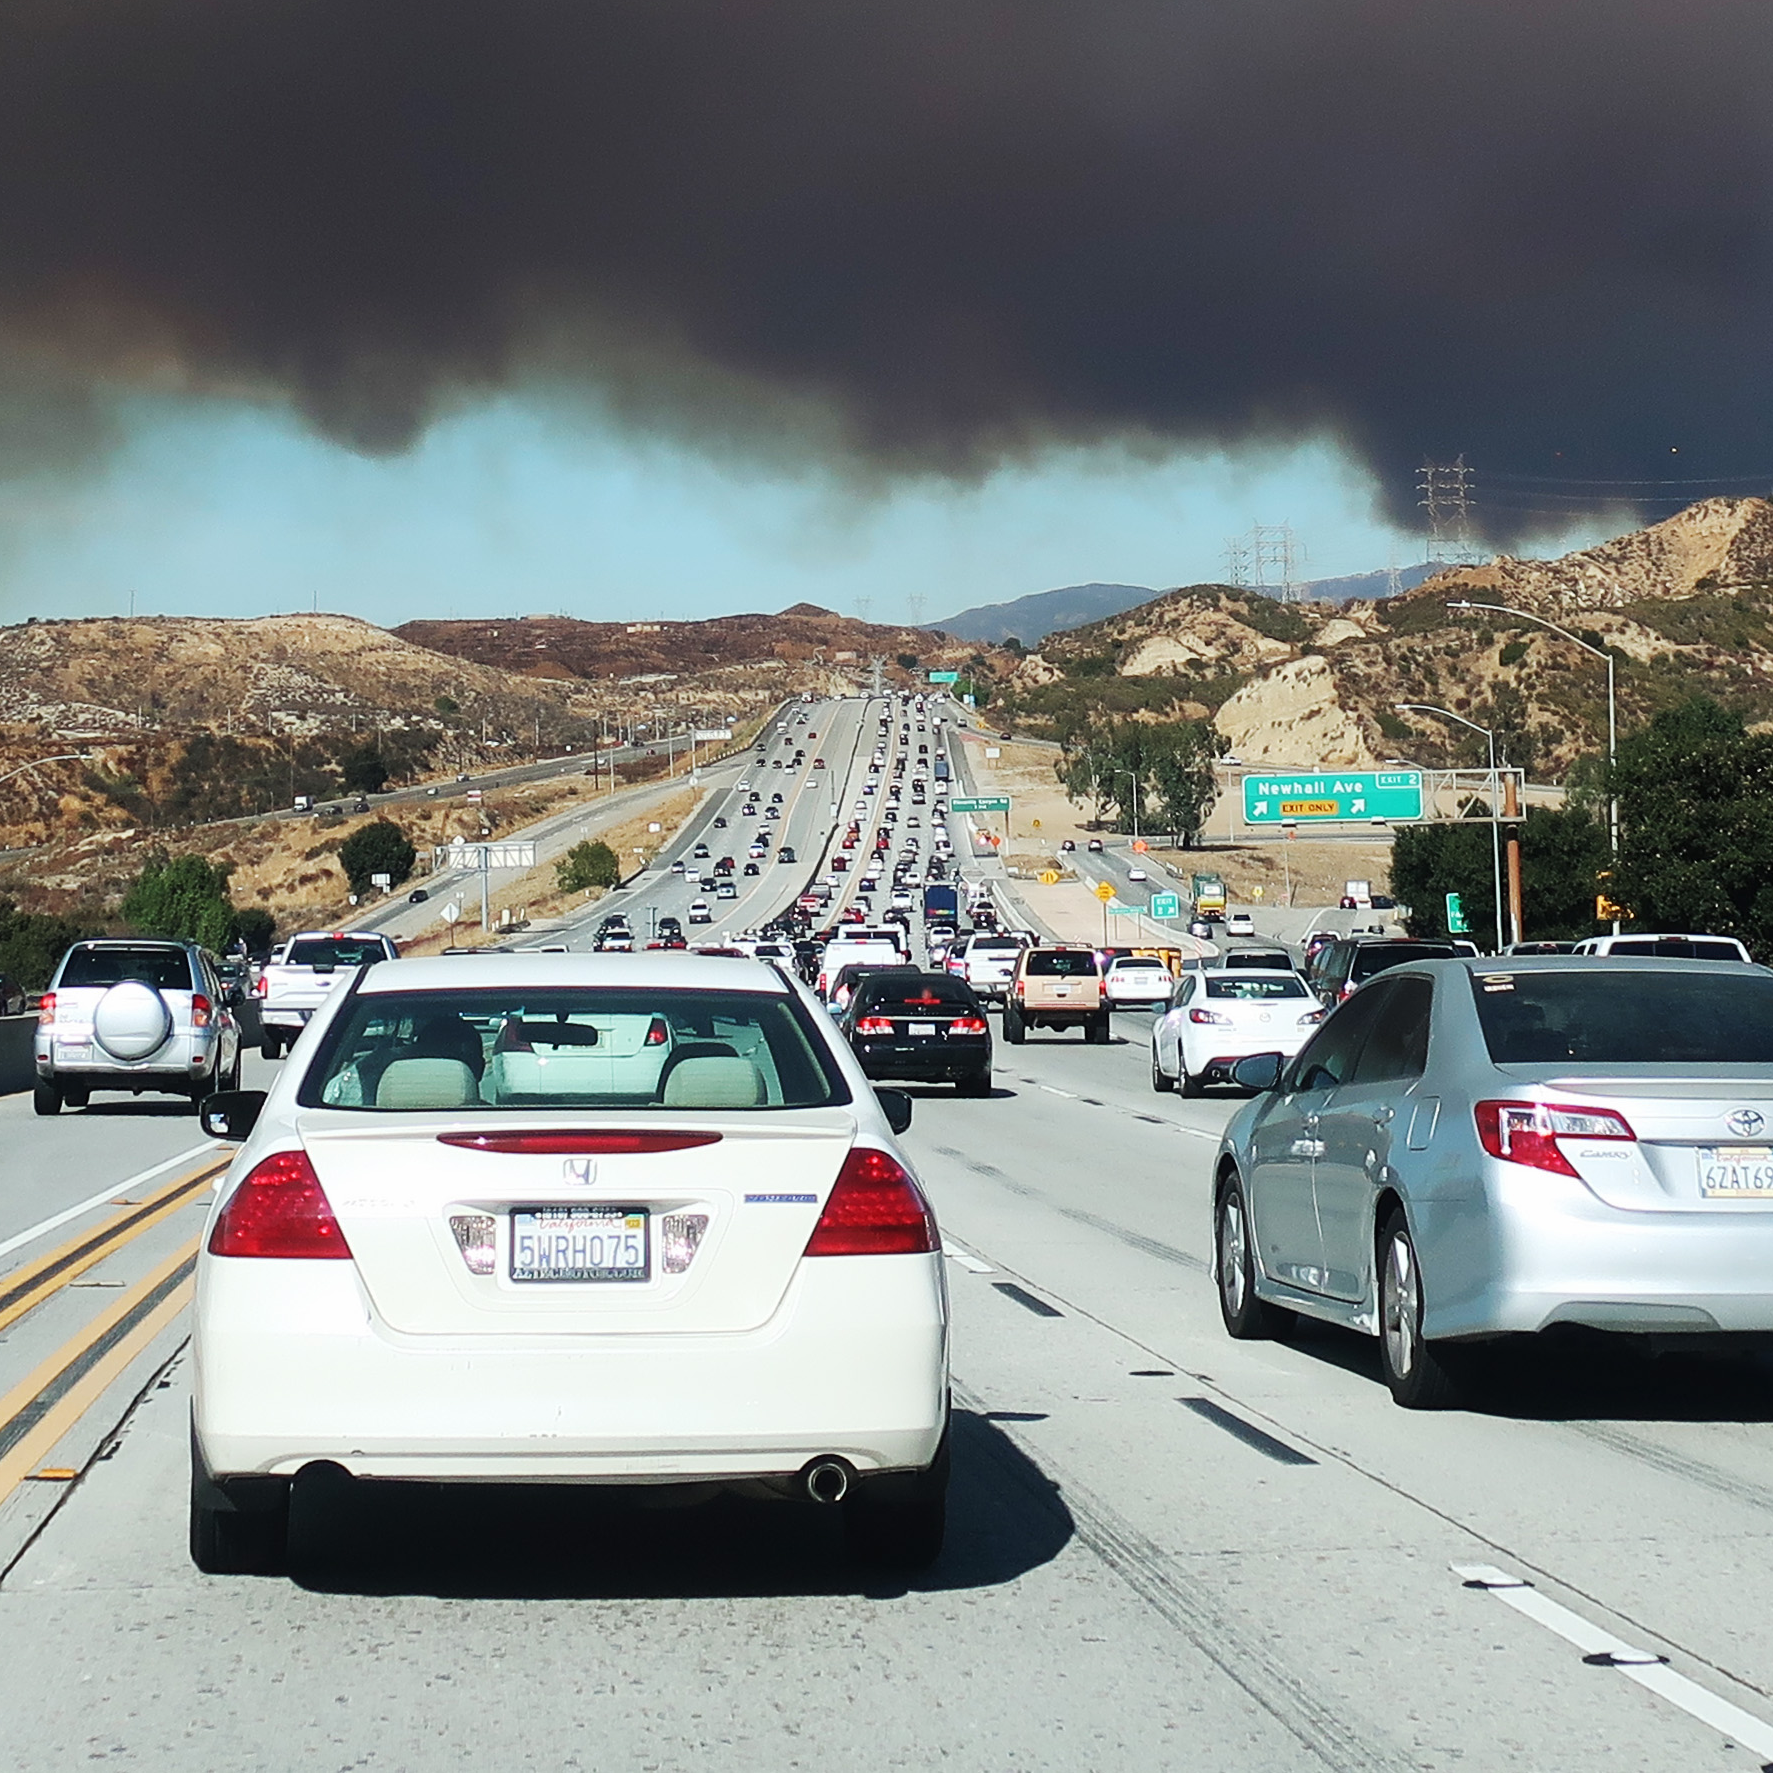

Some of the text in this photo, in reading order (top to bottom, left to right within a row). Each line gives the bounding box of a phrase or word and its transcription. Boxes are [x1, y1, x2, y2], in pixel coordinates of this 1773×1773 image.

[1380, 774, 1418, 785] EXIT 2
[1258, 780, 1363, 796] Newhall Ave
[1282, 803, 1335, 813] EXIT ONLY
[520, 1234, 640, 1268] 5WRH075
